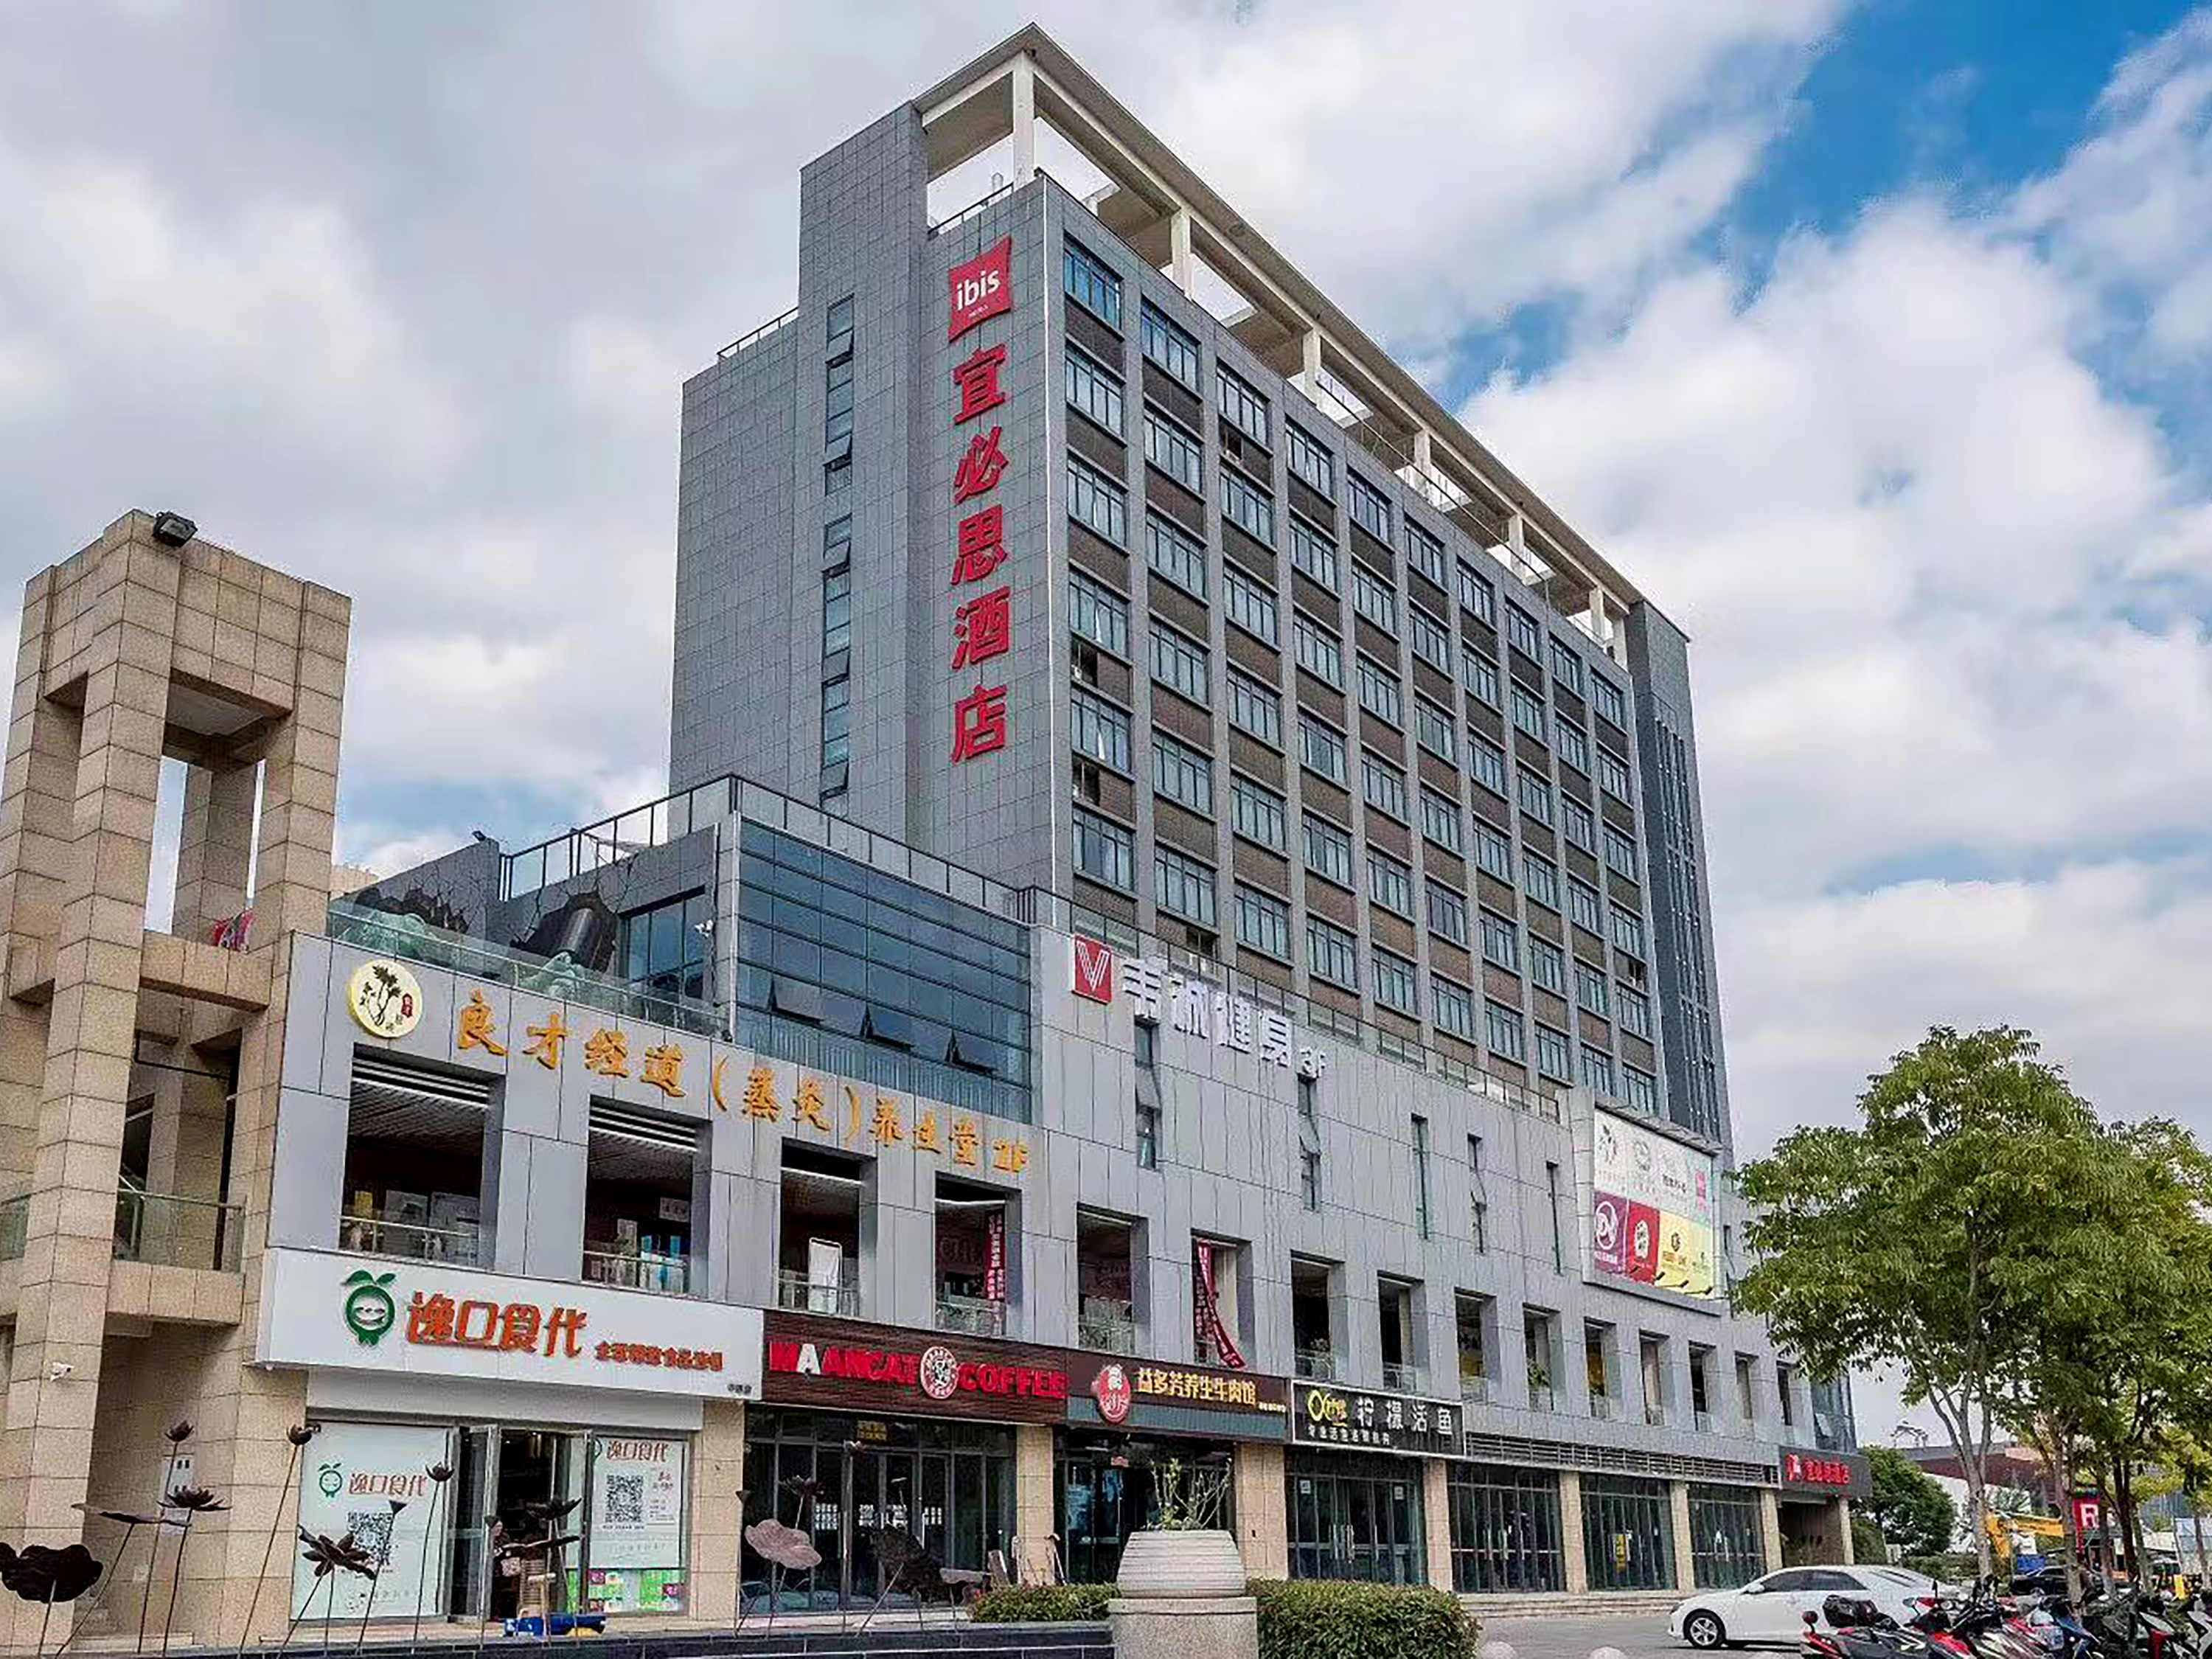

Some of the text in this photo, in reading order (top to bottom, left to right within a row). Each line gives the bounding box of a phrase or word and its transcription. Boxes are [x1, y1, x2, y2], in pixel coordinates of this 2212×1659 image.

[956, 270, 1001, 311] ibis
[952, 344, 1010, 763] 宜必思酒店
[959, 1363, 1067, 1399] COFFEE
[1357, 1396, 1453, 1436] 柠檬活鱼
